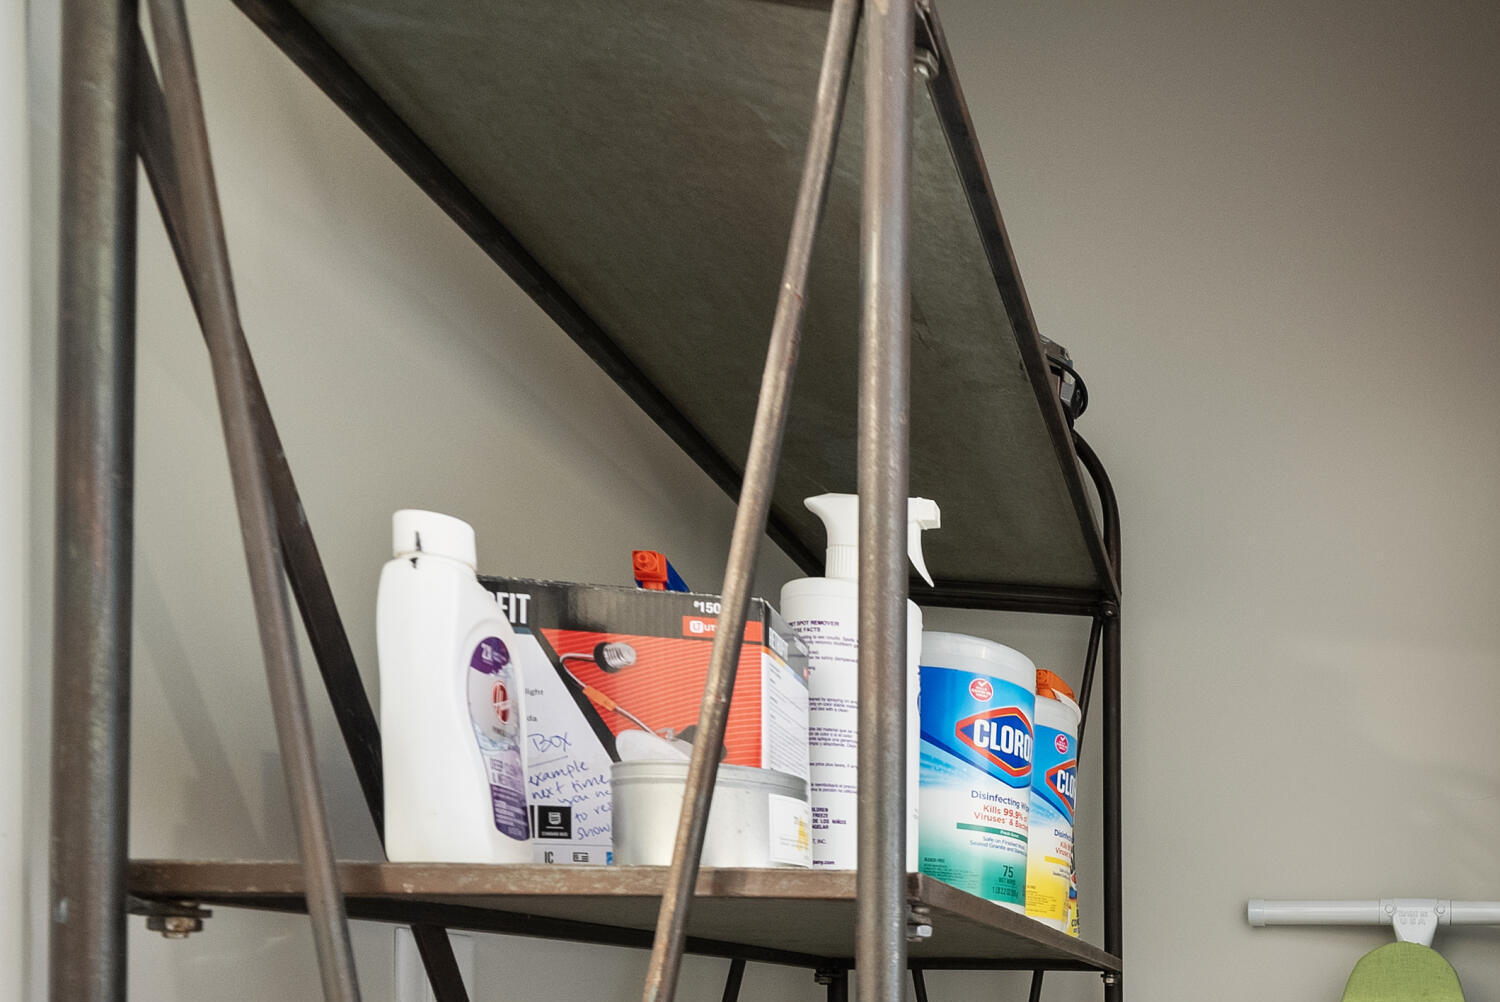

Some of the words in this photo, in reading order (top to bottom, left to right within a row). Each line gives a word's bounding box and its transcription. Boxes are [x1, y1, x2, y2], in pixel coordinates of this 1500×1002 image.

[489, 591, 531, 625] FIT
[973, 718, 1032, 763] CLORO
[971, 790, 1021, 809] Disinfecting
[983, 804, 1001, 815] Kills
[1003, 865, 1014, 879] 75
